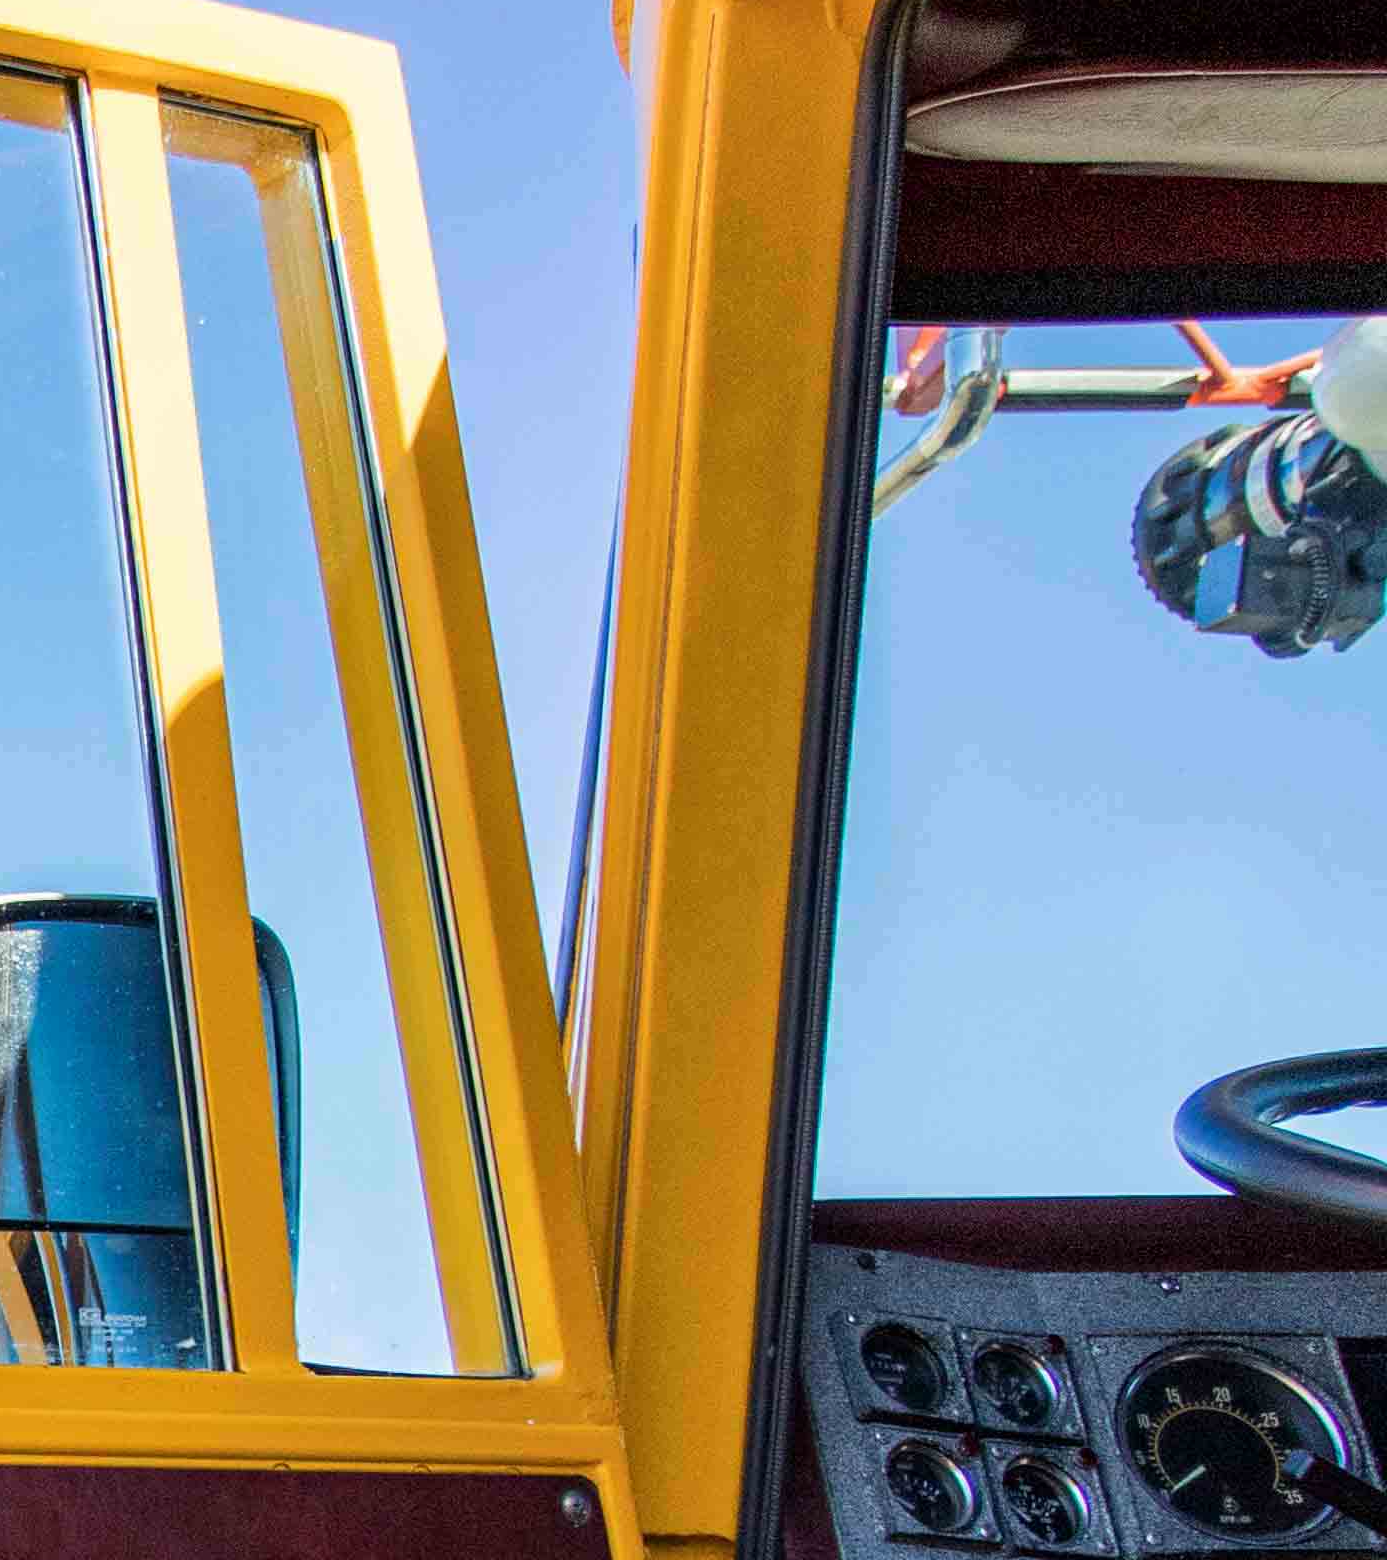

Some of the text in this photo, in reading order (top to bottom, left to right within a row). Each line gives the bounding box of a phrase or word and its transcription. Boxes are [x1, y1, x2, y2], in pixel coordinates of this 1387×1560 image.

[1165, 1388, 1180, 1403] 15
[1213, 1387, 1232, 1402] 20
[1260, 1412, 1280, 1427] 25
[1283, 1490, 1304, 1505] 35
